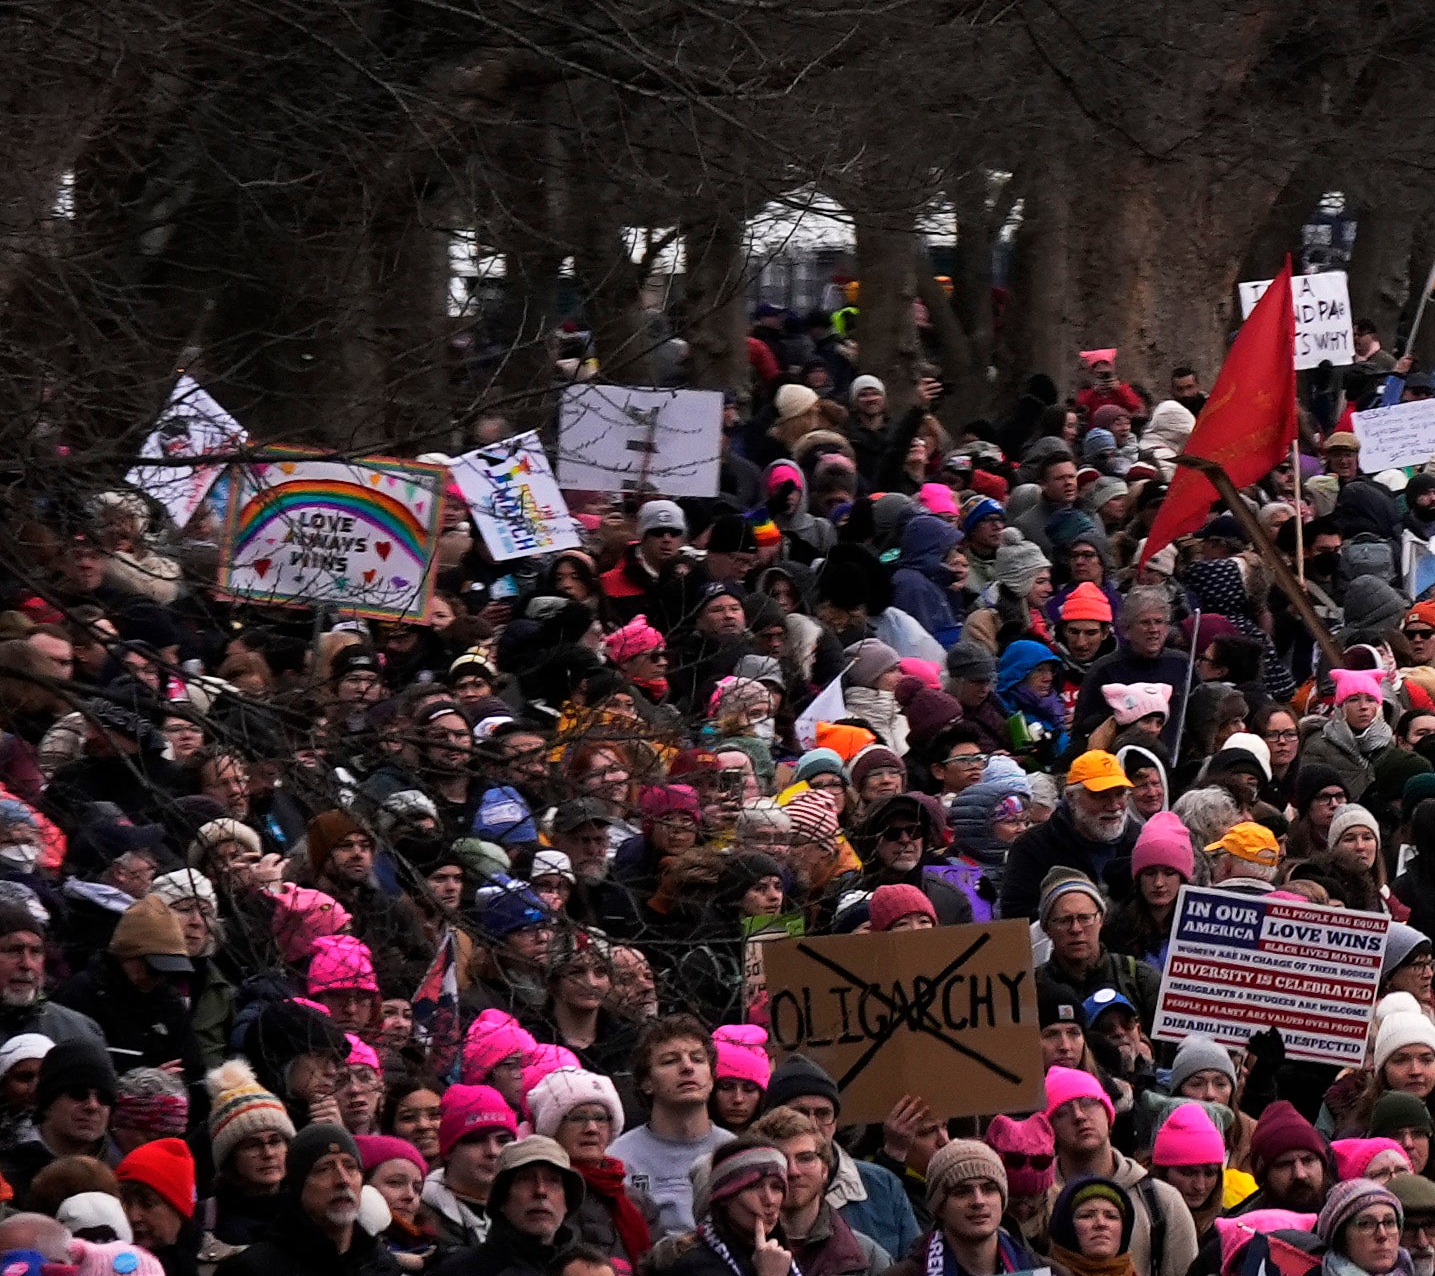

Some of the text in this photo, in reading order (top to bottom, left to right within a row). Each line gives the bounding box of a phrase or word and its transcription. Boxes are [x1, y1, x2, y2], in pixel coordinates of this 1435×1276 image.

[1312, 329, 1349, 352] WHY
[300, 511, 355, 534] LOVE
[286, 530, 369, 554] ALWAYS
[1187, 900, 1259, 925] IN OUR
[1271, 906, 1387, 932] ALL PEOPLE ARE EQUAL
[1183, 920, 1255, 942] AMERICA
[1267, 922, 1383, 952] LOVE WINS
[1177, 944, 1376, 980] WOMEN ARE IN CHARGE OF THEIR BODIES
[1264, 941, 1374, 967] BLACK LIVES MATTER
[1171, 960, 1374, 1002] DIVERSITY IS CELEBRATED
[770, 970, 1028, 1053] OLIGARCHY
[1169, 980, 1369, 1019] IMMIGRANTS & REFUGEES ARE WELCOME
[1166, 997, 1202, 1013] PEOPLE
[1209, 1004, 1247, 1019] PLANET
[1247, 1009, 1267, 1022] ARE
[1267, 1012, 1304, 1027] VALUED
[1304, 1018, 1331, 1031] OVER
[1331, 1022, 1365, 1035] PROFIT
[1162, 1015, 1362, 1055] DISABILITIES RESPECTED
